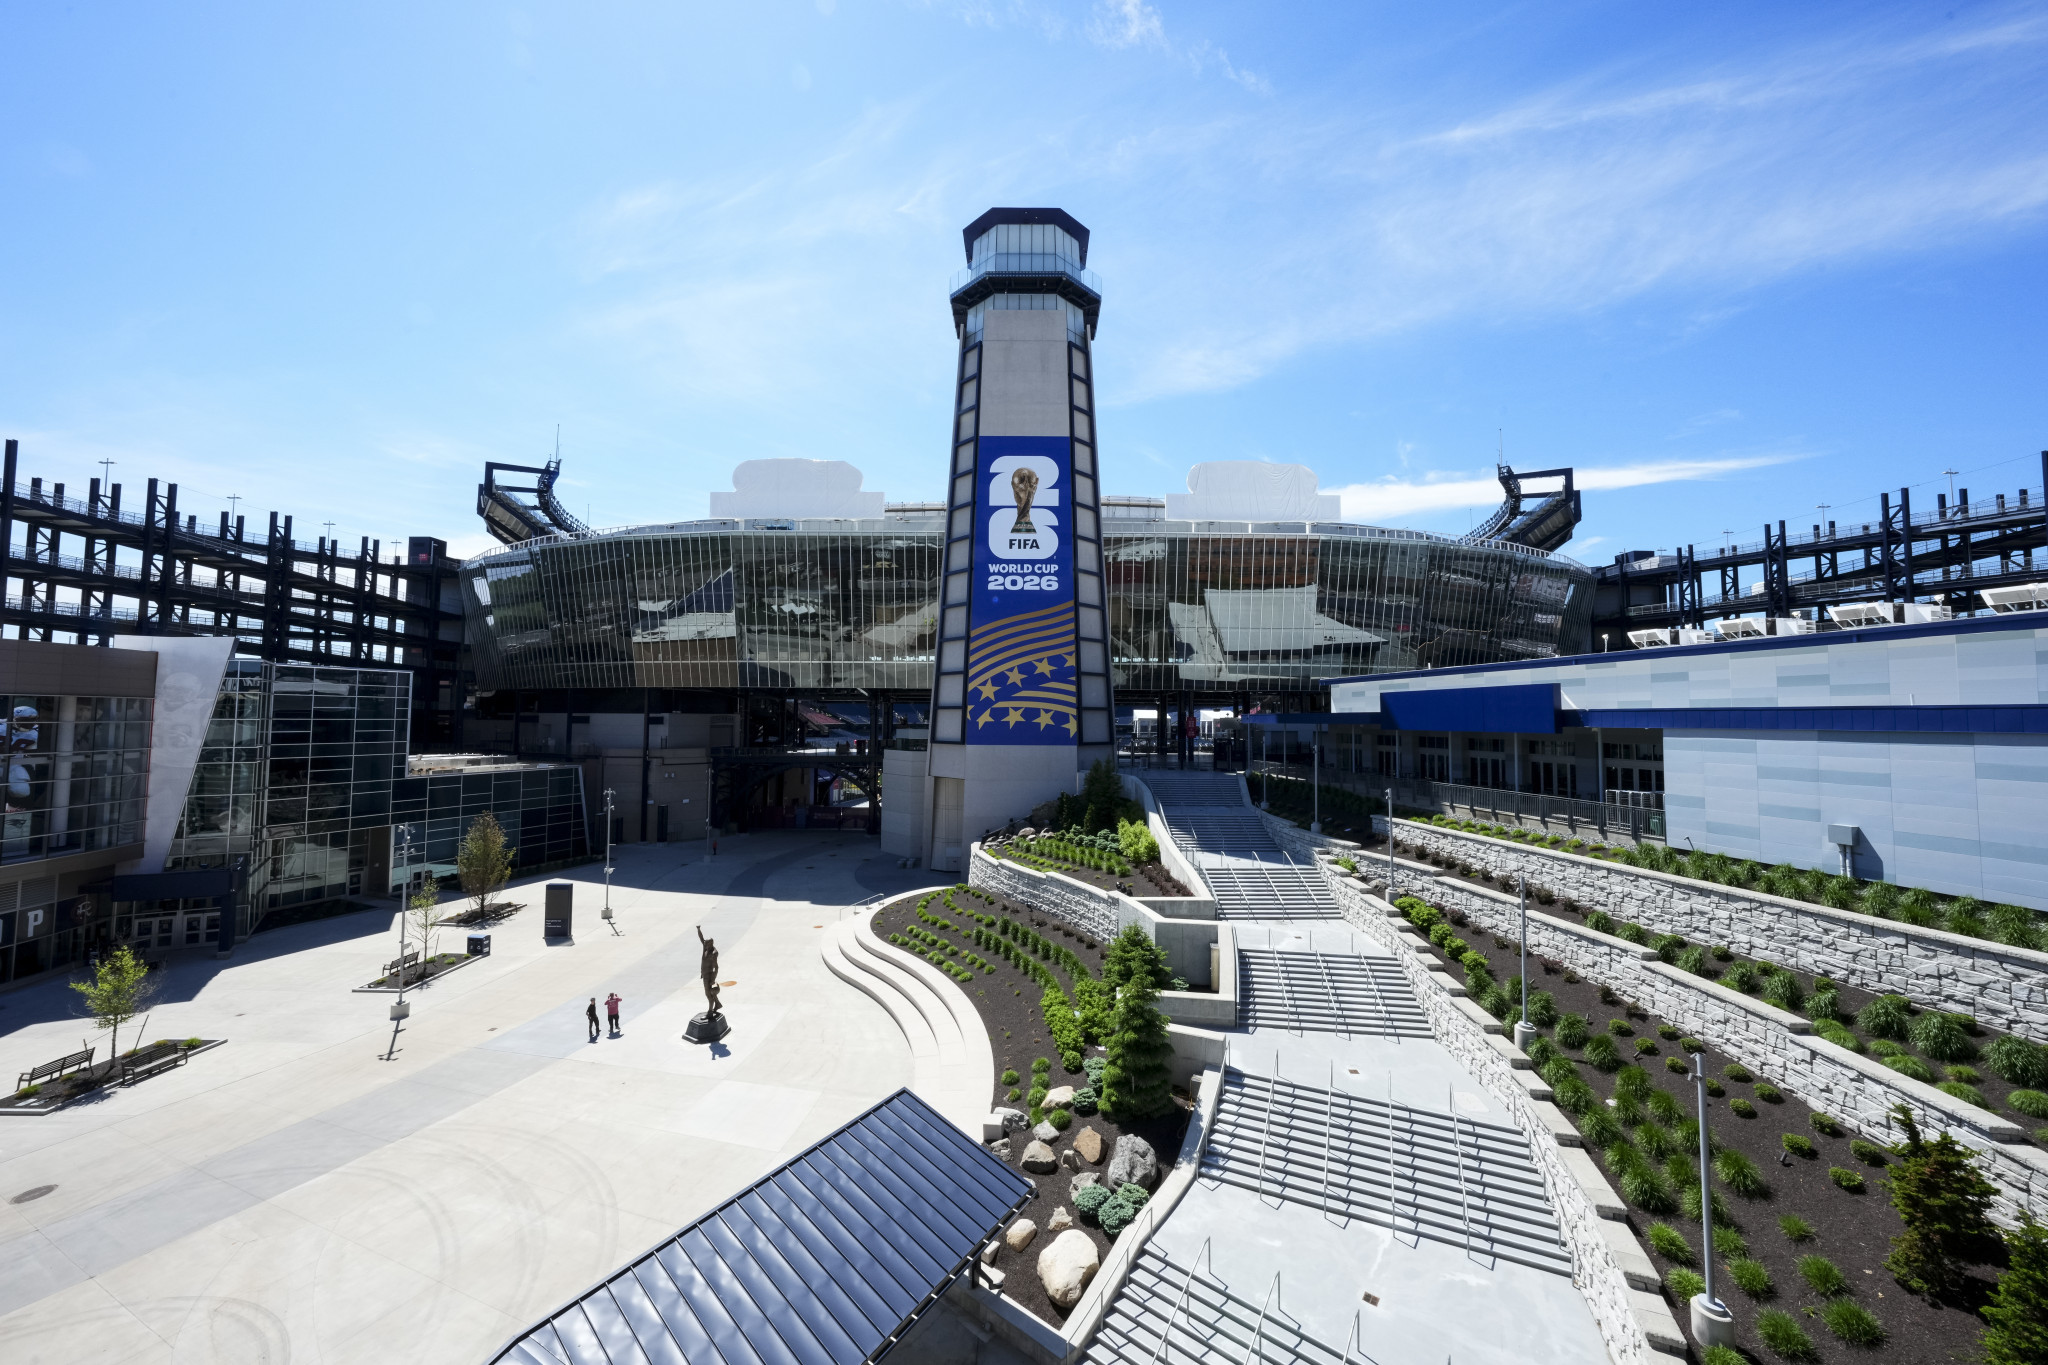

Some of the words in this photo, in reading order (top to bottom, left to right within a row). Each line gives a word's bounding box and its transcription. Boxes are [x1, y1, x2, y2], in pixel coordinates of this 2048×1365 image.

[1008, 538, 1040, 550] FIFA
[988, 563, 1032, 574] WORLD
[1034, 563, 1059, 574] CUP
[987, 575, 1059, 591] 2026
